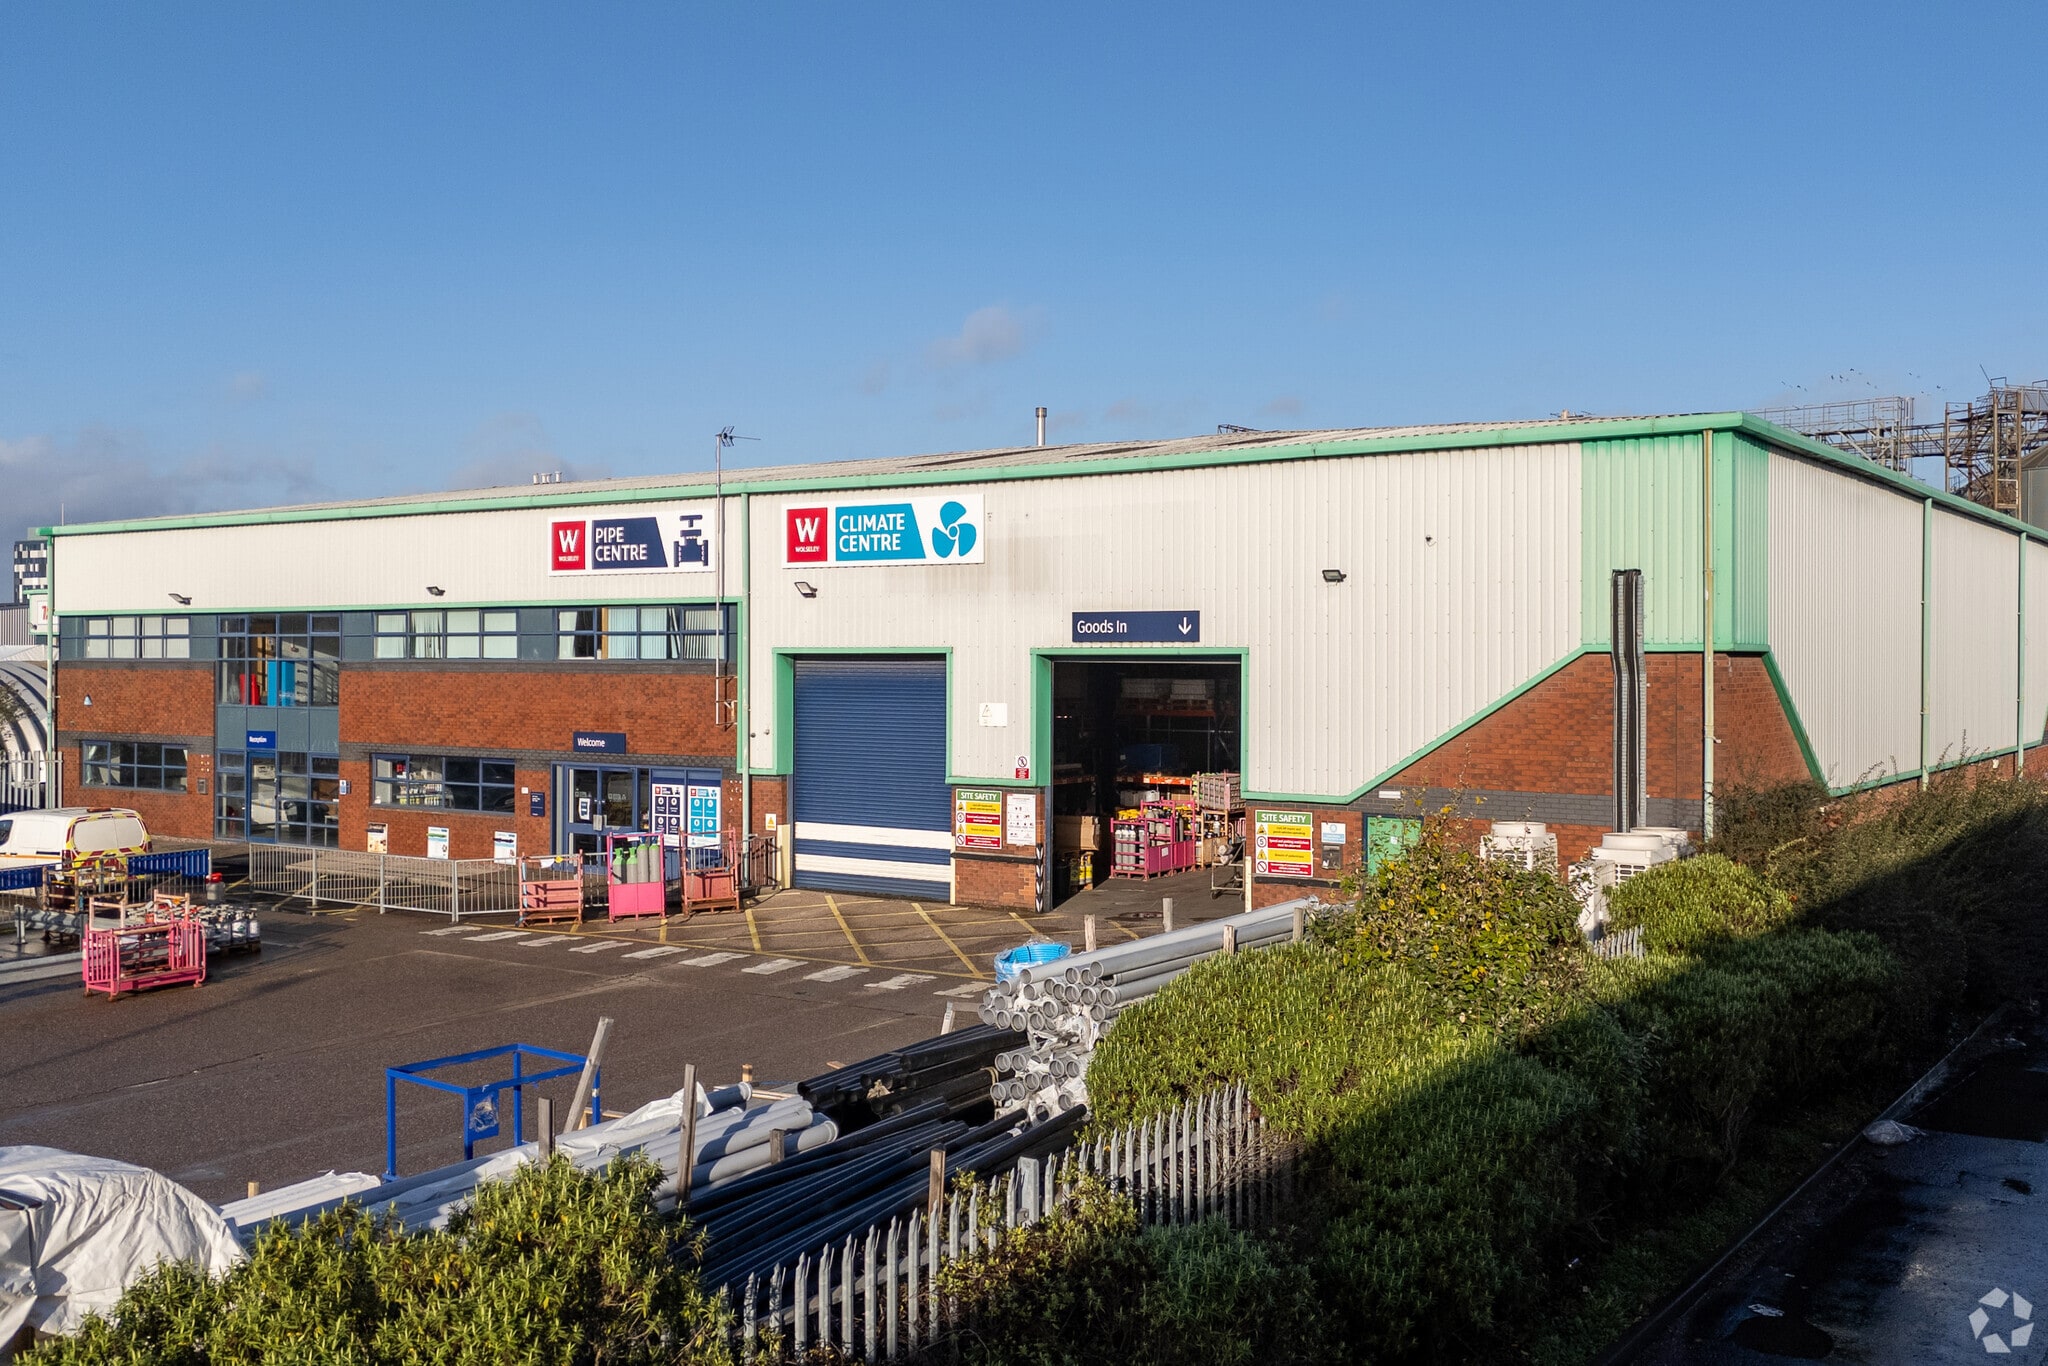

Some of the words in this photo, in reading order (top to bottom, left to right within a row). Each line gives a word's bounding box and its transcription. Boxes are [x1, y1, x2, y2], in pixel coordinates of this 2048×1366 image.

[795, 517, 820, 543] W
[839, 513, 905, 533] CLIMATE
[558, 529, 580, 553] W
[595, 527, 625, 543] PIPE
[839, 533, 901, 552] CENTRE
[595, 544, 648, 562] CENTRE
[1077, 619, 1114, 634] Goods
[1116, 620, 1127, 633] In
[577, 737, 606, 748] Welcome
[961, 792, 974, 800] SITE
[974, 793, 997, 801] SAFETY
[1261, 813, 1278, 822] SITE
[1278, 814, 1306, 823] SAFETY
